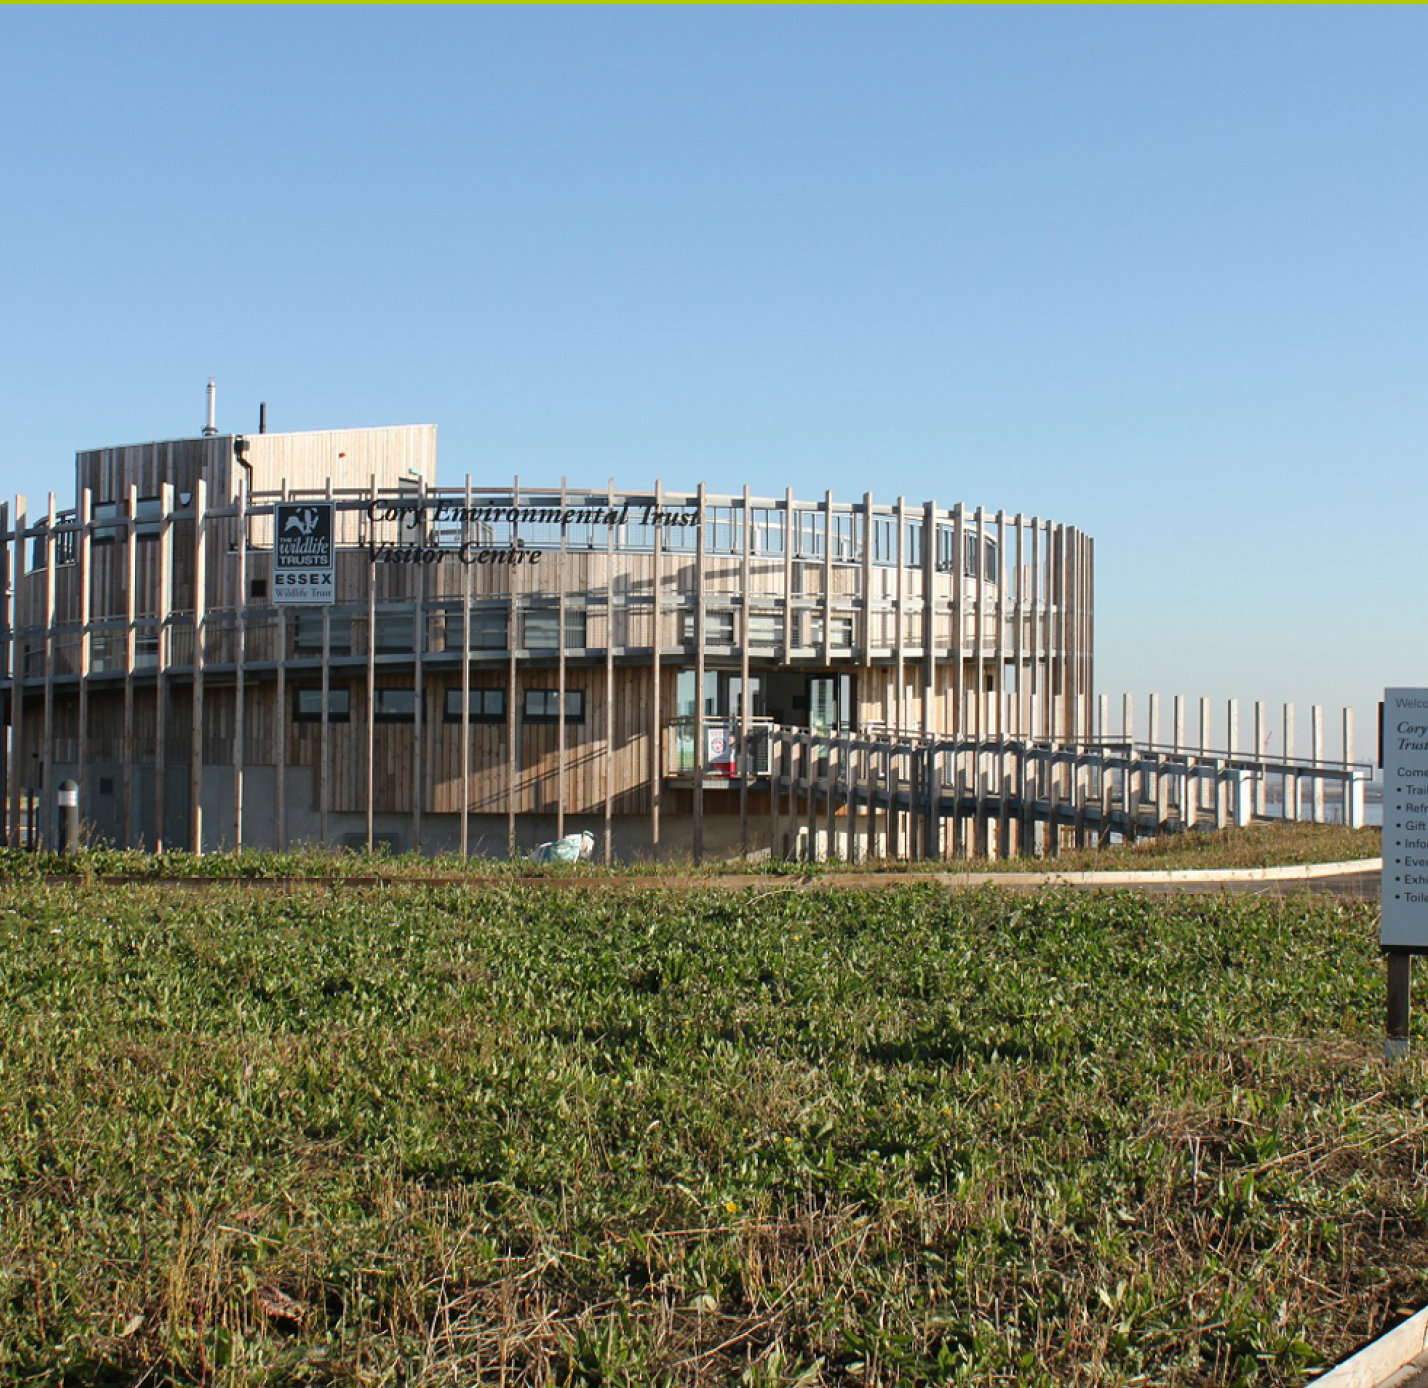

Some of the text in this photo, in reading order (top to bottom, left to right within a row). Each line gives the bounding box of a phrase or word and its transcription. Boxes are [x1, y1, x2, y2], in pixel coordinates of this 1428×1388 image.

[368, 499, 702, 529] Cory Environmental Trust
[279, 536, 329, 555] wildlife
[369, 541, 542, 565] Visitor Centre
[279, 555, 328, 565] TRUSTS
[275, 573, 332, 584] ESSEX
[275, 587, 332, 597] Wildlife Trust
[1397, 721, 1427, 738] Cory
[1398, 738, 1428, 750] Trust
[1405, 820, 1426, 831] Gift
